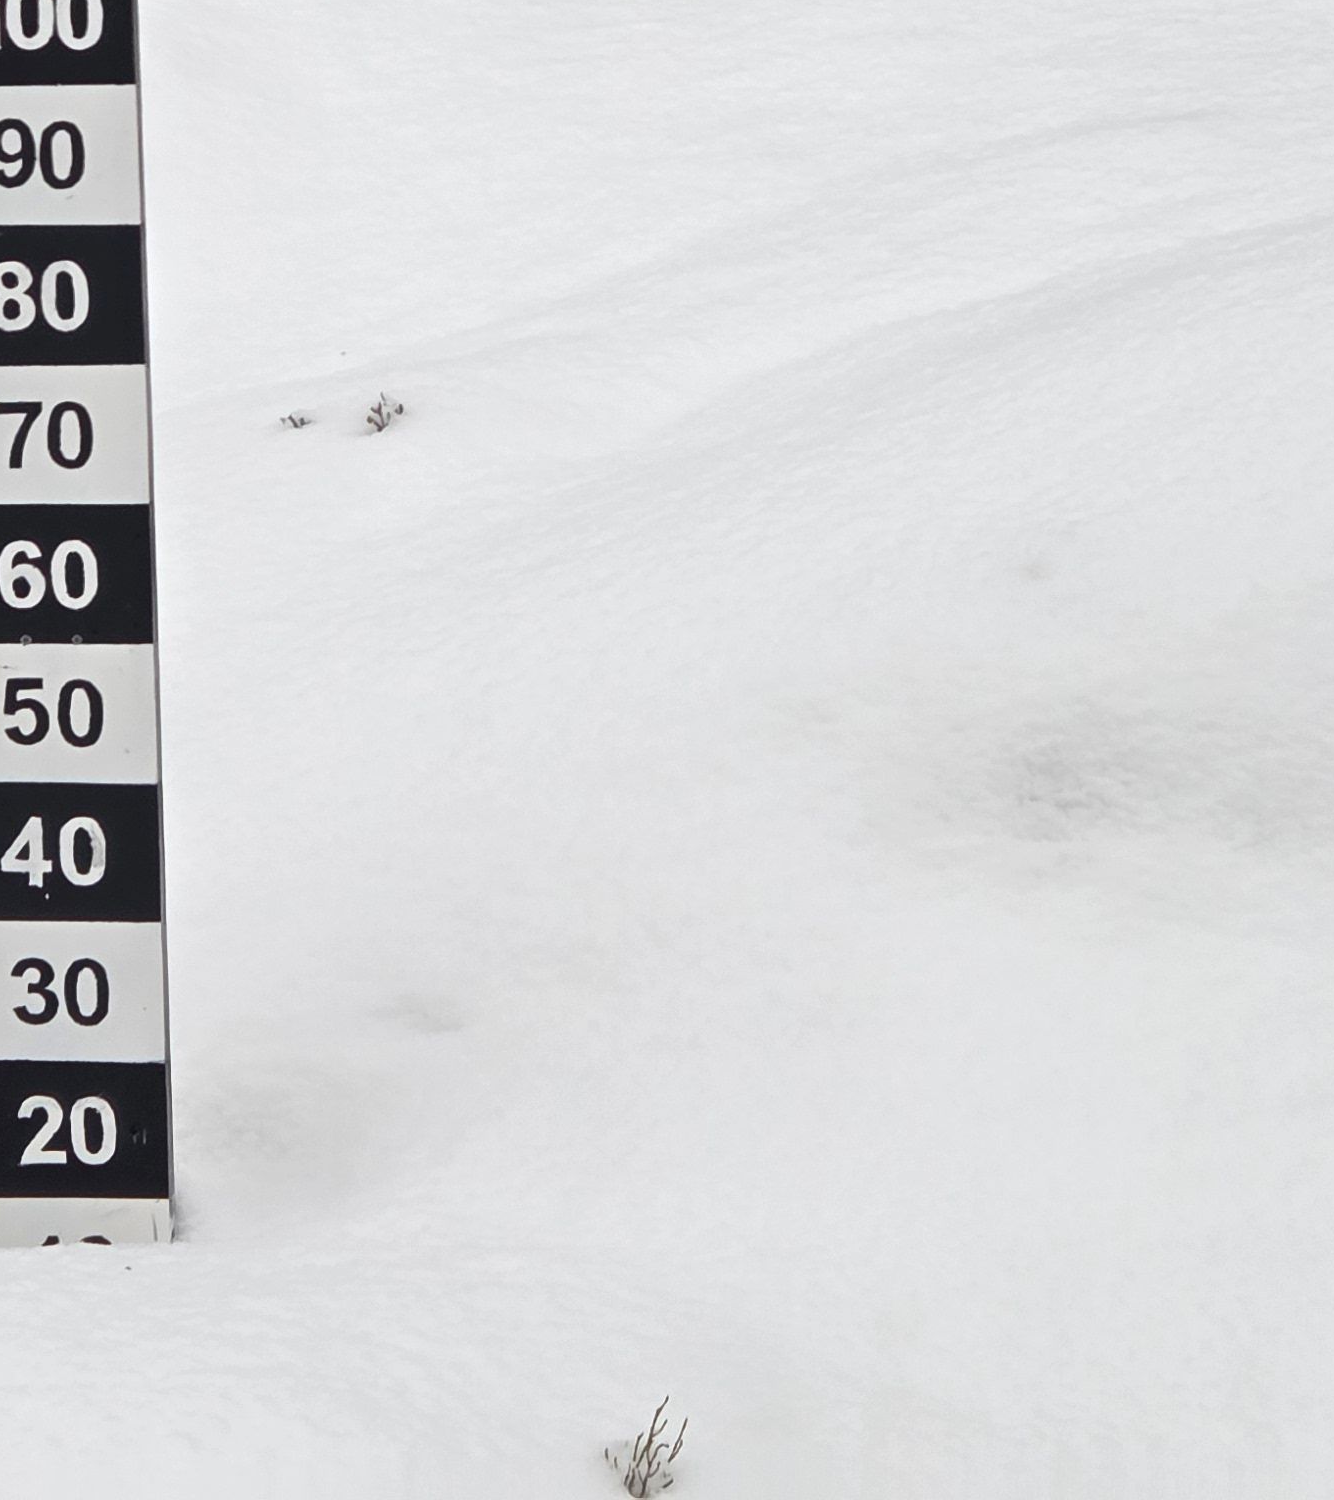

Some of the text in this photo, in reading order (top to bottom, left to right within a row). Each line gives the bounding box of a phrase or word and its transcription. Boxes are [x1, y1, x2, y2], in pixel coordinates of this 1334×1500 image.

[3, 677, 104, 748] 50
[0, 816, 106, 888] 40
[10, 957, 110, 1027] 30
[17, 1095, 117, 1166] 20
